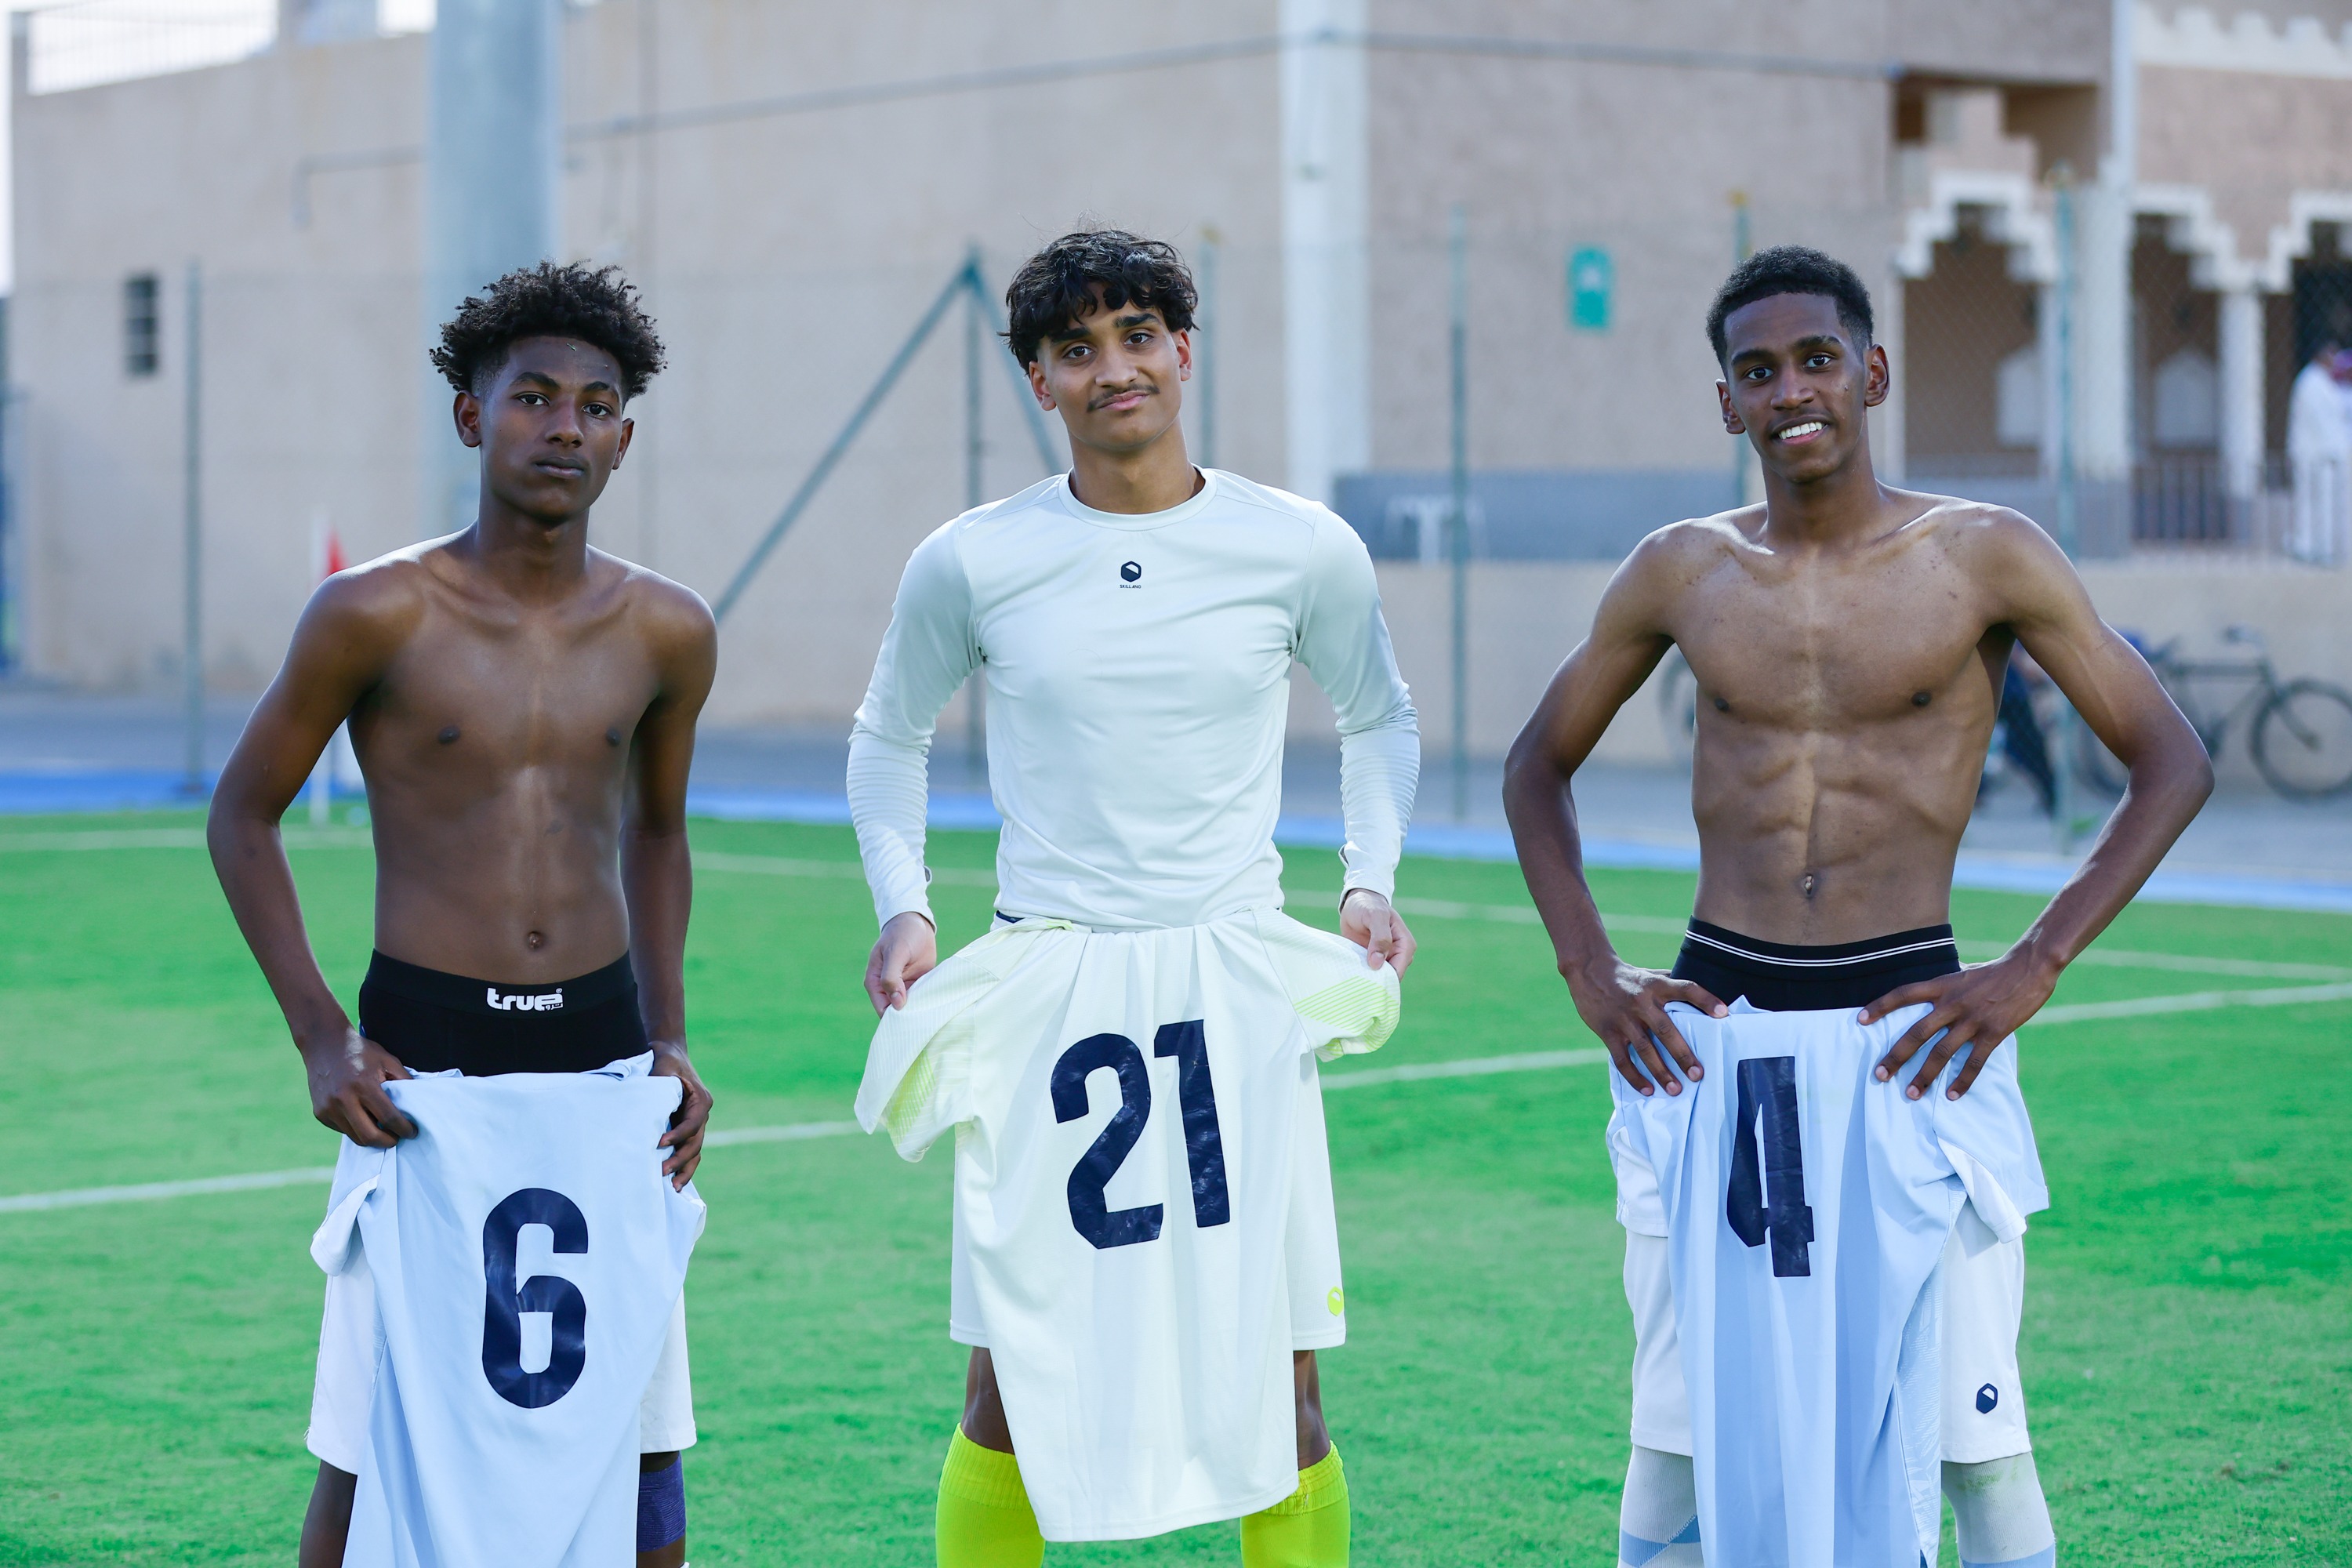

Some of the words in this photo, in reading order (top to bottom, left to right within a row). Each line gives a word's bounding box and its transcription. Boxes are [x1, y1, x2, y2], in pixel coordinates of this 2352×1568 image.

[1051, 1019, 1230, 1249] 21
[1726, 1056, 1814, 1277] 4
[482, 1188, 588, 1408] 6
